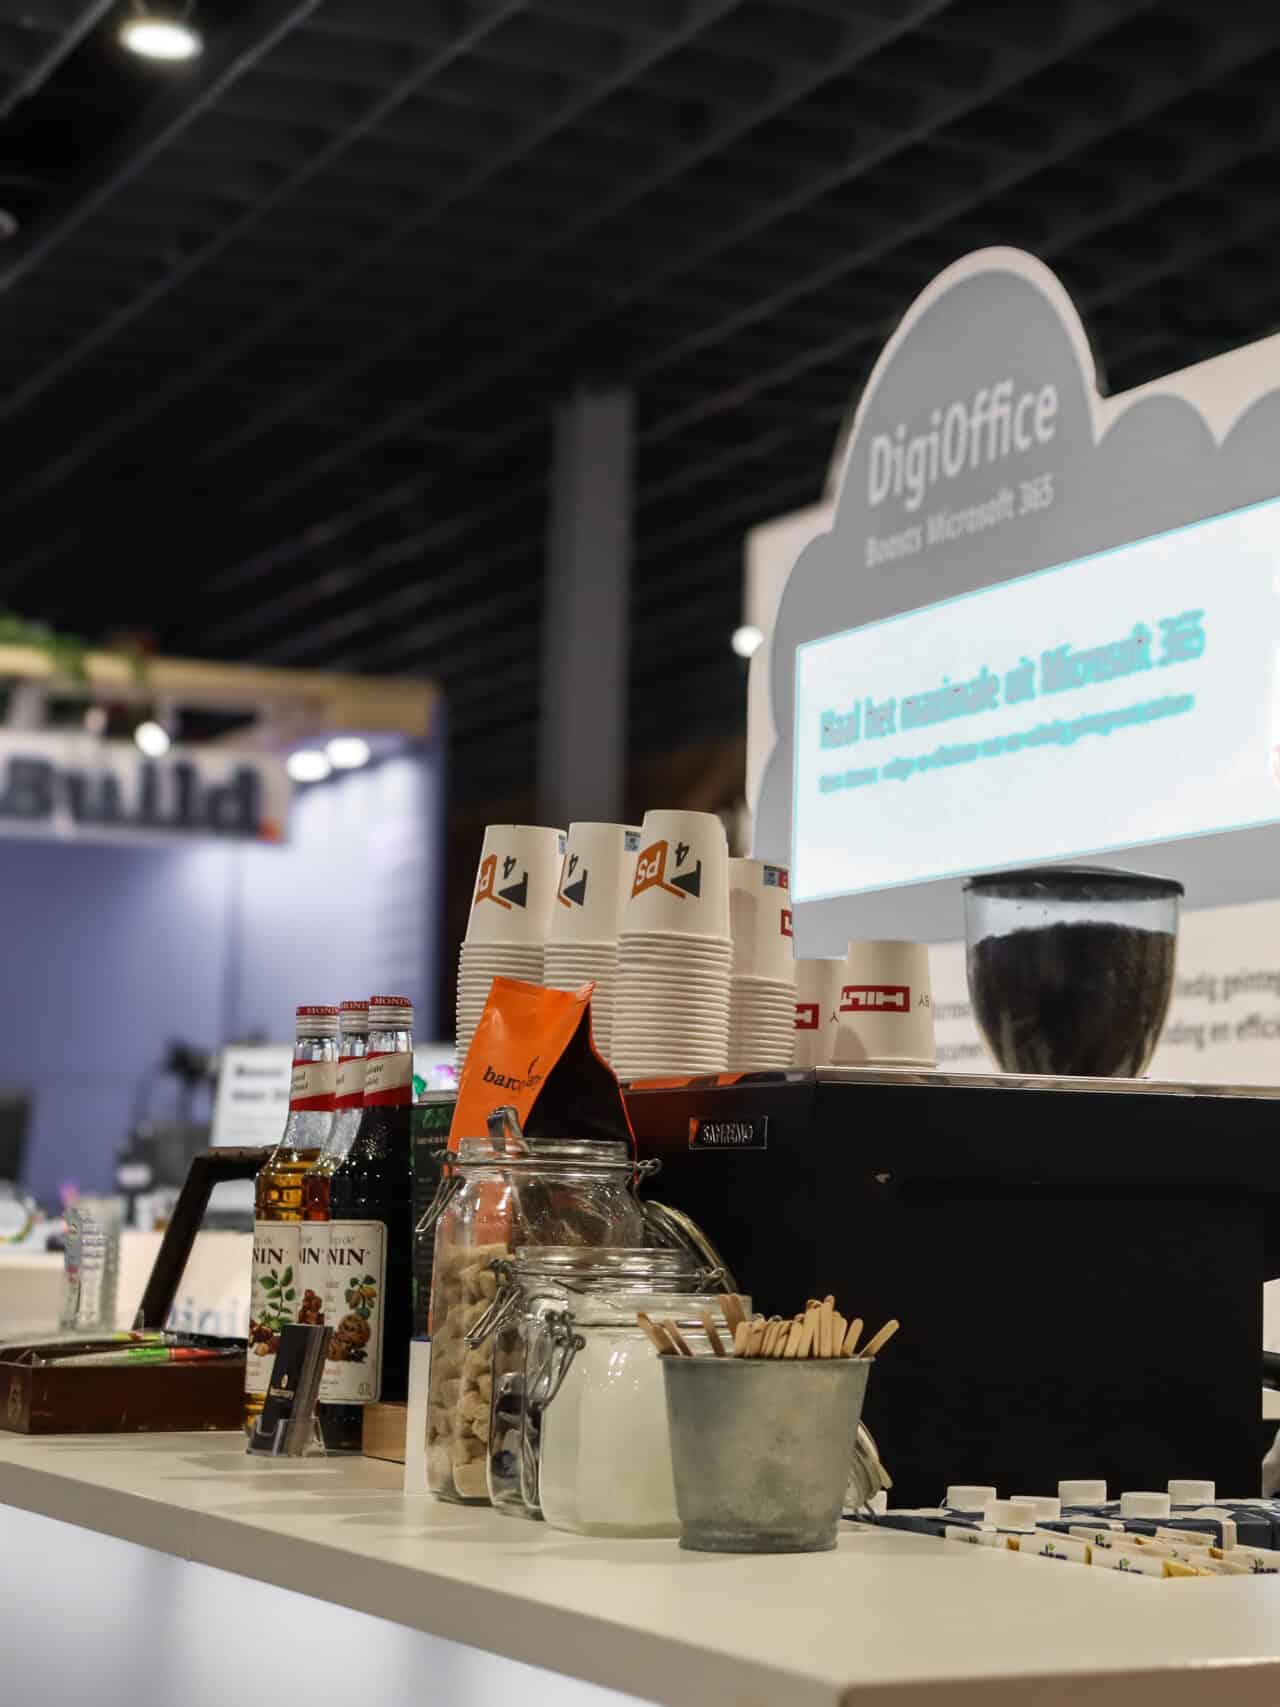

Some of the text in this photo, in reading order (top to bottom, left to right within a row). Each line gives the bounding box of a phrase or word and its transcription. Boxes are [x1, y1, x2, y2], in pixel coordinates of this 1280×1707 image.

[868, 379, 1058, 512] DigiOffice
[865, 472, 1055, 568] Boosts Microsoft 365
[1040, 621, 1153, 695] Microsoft
[1156, 608, 1206, 667] 365
[479, 863, 492, 893] P
